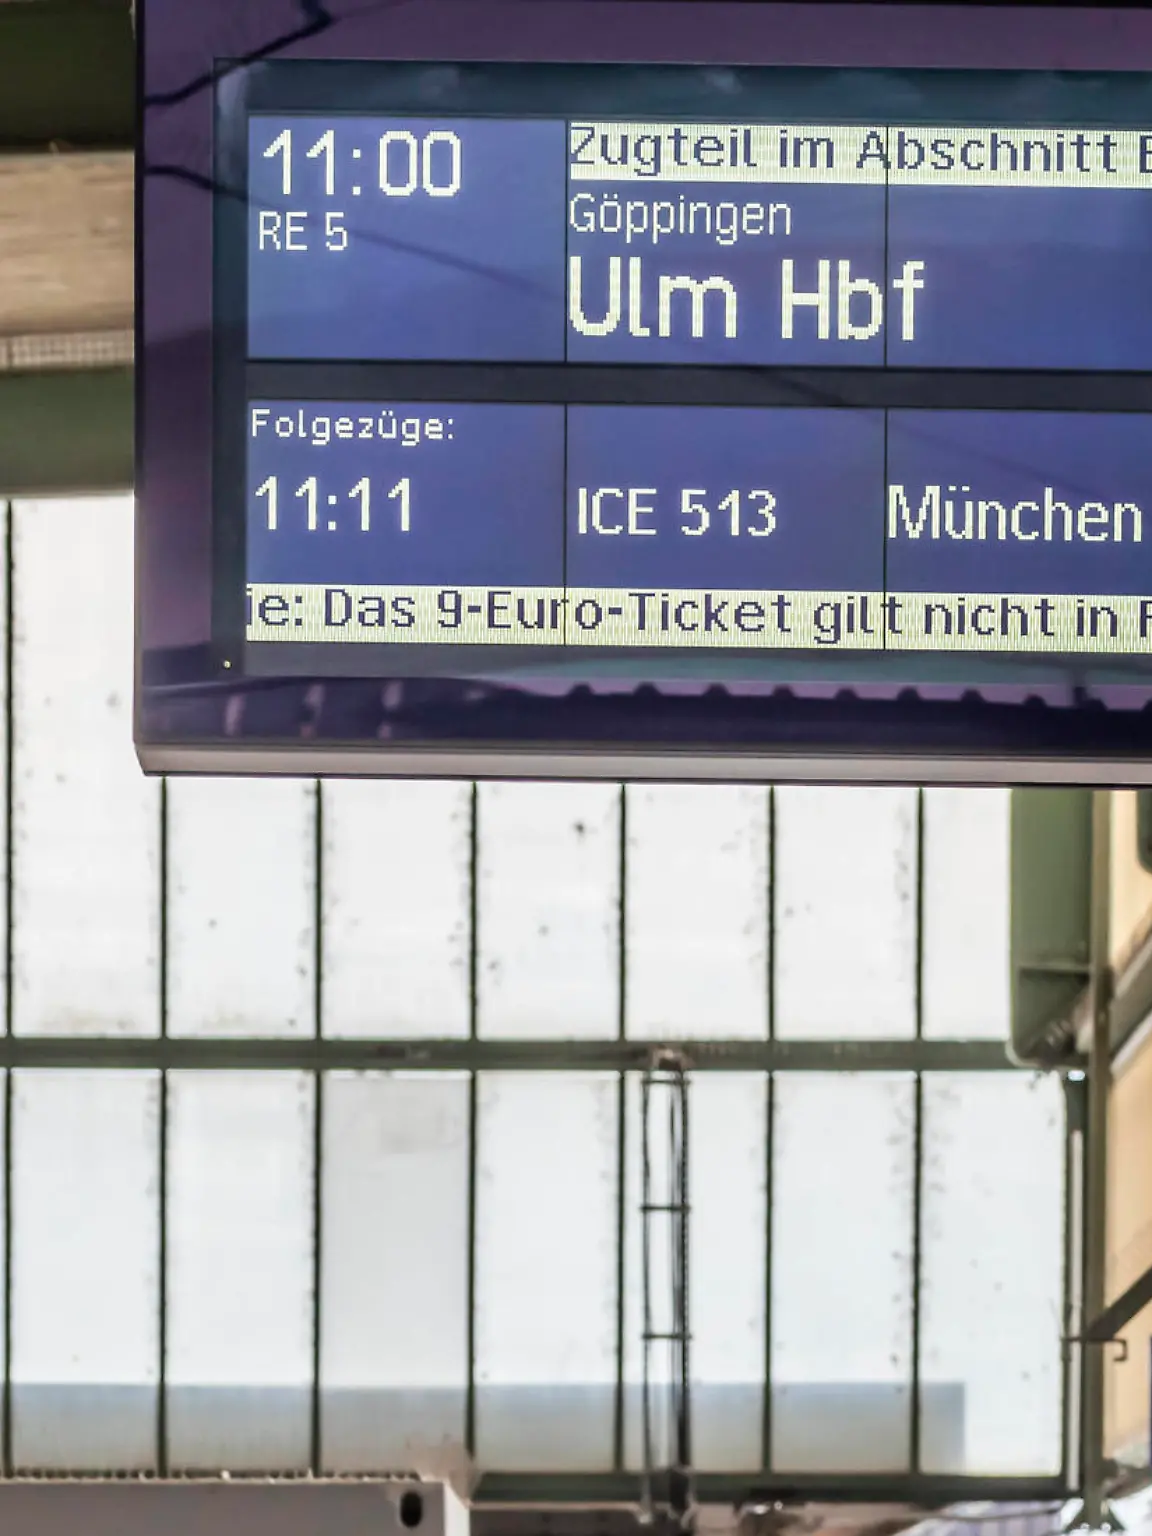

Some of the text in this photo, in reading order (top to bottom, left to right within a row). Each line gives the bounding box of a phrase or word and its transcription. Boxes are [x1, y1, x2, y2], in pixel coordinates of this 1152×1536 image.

[263, 129, 461, 197] 11:00
[570, 126, 757, 176] Zugteil
[780, 129, 834, 168] im
[856, 131, 1117, 173] Abschnitt
[259, 210, 348, 251] RE 5
[569, 192, 791, 245] Göppingen
[569, 255, 925, 341] Ulm Hbf
[252, 408, 454, 447] Folgezüge:
[255, 475, 410, 532] 11:11
[578, 487, 657, 535] ICE
[681, 488, 776, 537] 513
[888, 484, 1142, 543] München
[324, 588, 416, 628] Das
[437, 590, 791, 632] 9-Euro-Ticket
[813, 595, 902, 645] gilt
[924, 596, 1056, 637] nicht
[1076, 599, 1118, 638] in
